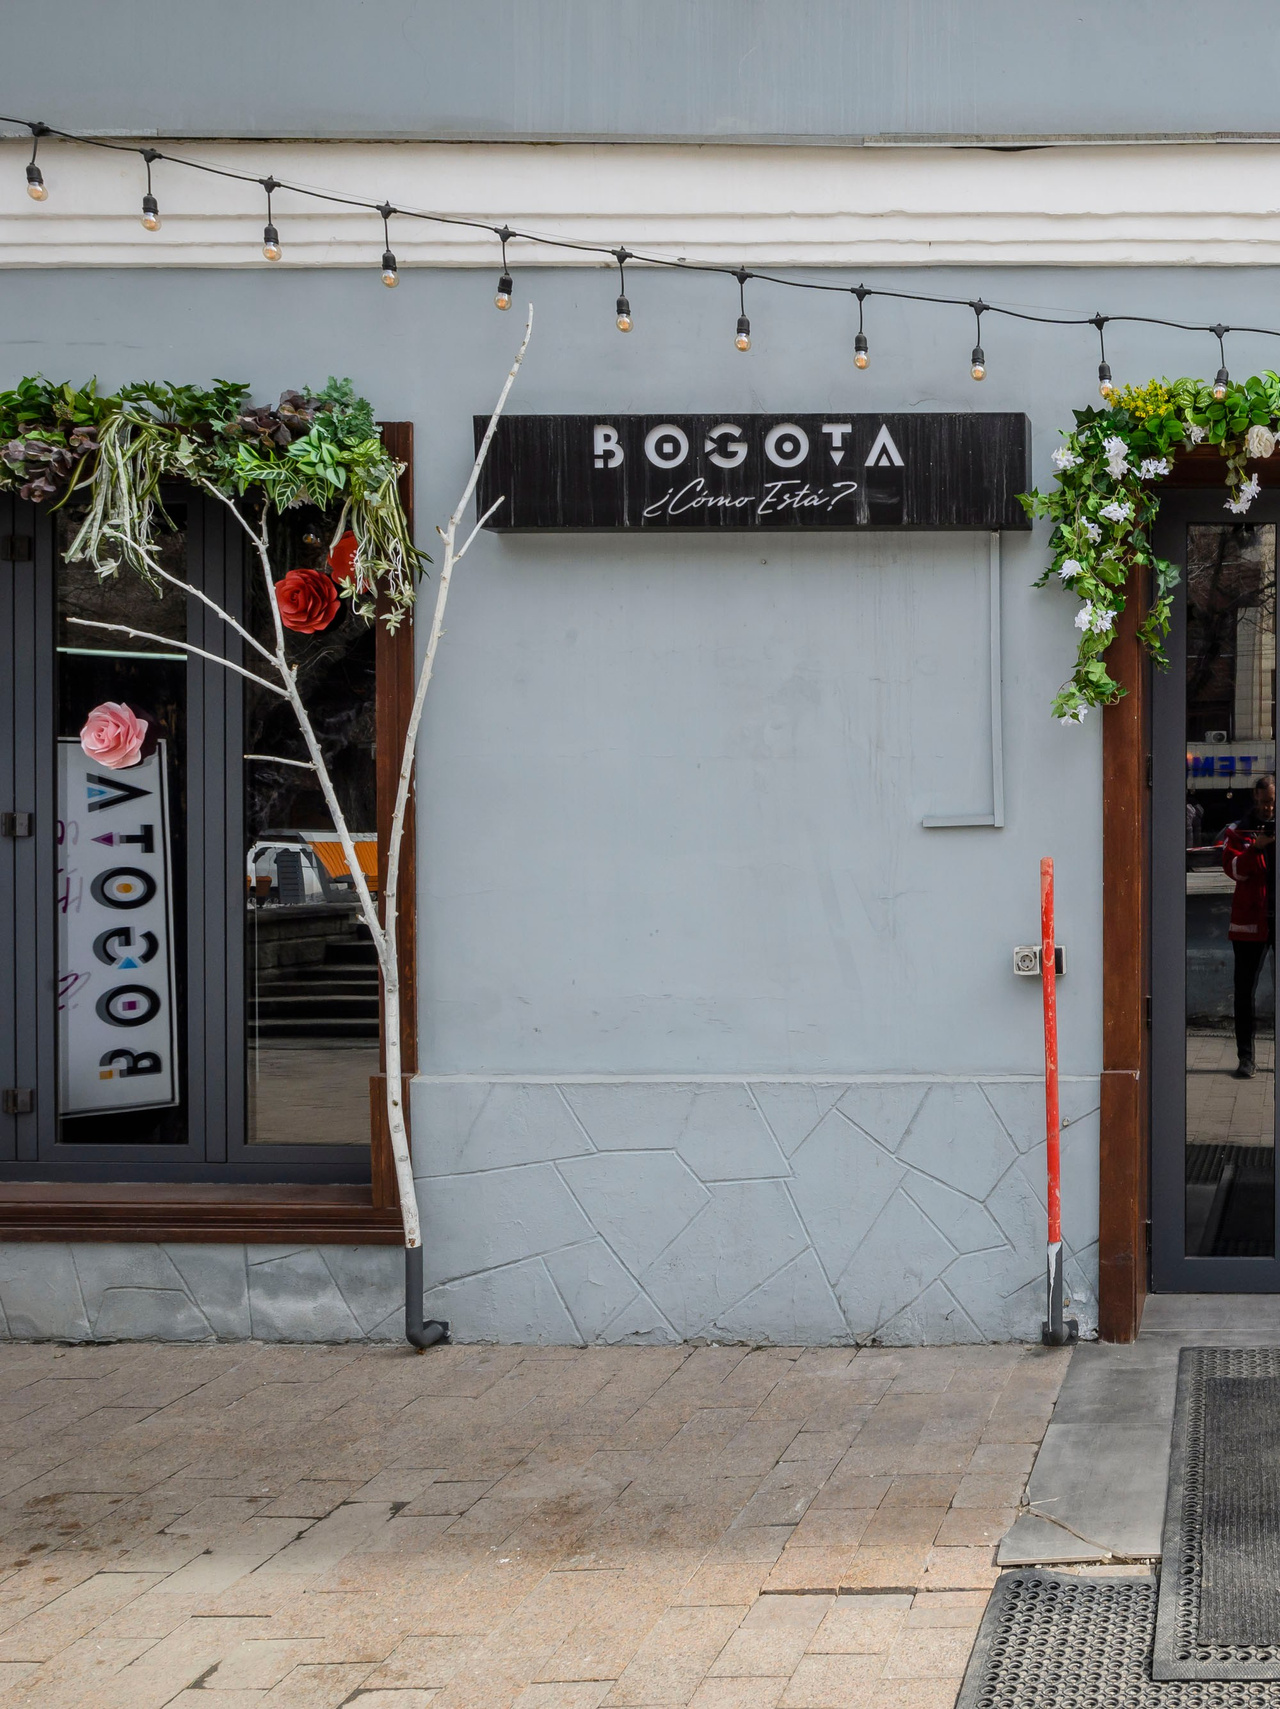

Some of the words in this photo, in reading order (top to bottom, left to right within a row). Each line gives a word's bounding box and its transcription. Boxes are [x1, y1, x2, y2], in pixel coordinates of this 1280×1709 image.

[593, 422, 905, 469] BOGOTA
[643, 477, 755, 517] ¿Cómo
[757, 479, 858, 514] Está?
